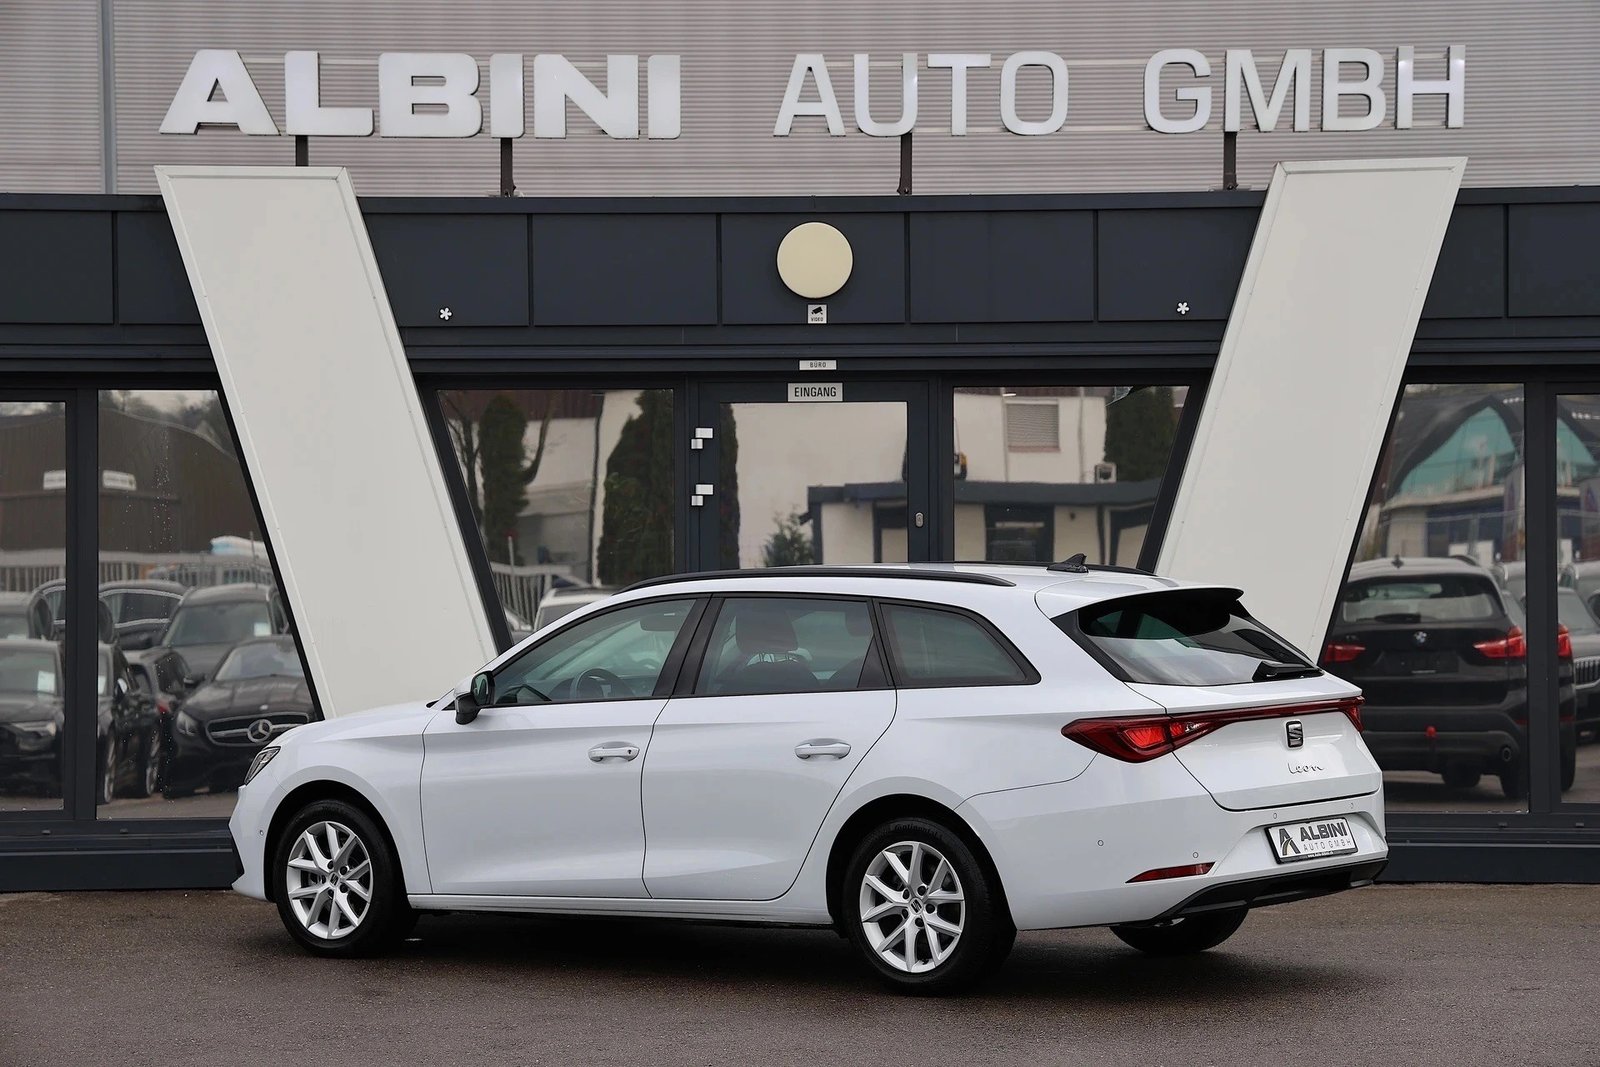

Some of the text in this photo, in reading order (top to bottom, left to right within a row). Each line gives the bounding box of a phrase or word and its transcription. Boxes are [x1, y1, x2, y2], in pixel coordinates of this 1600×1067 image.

[159, 44, 1466, 139] ALBINI AUTO GMBH
[794, 386, 837, 397] EINGANG
[1300, 822, 1348, 841] ALBINI
[1303, 838, 1352, 851] AUTO GMBH
